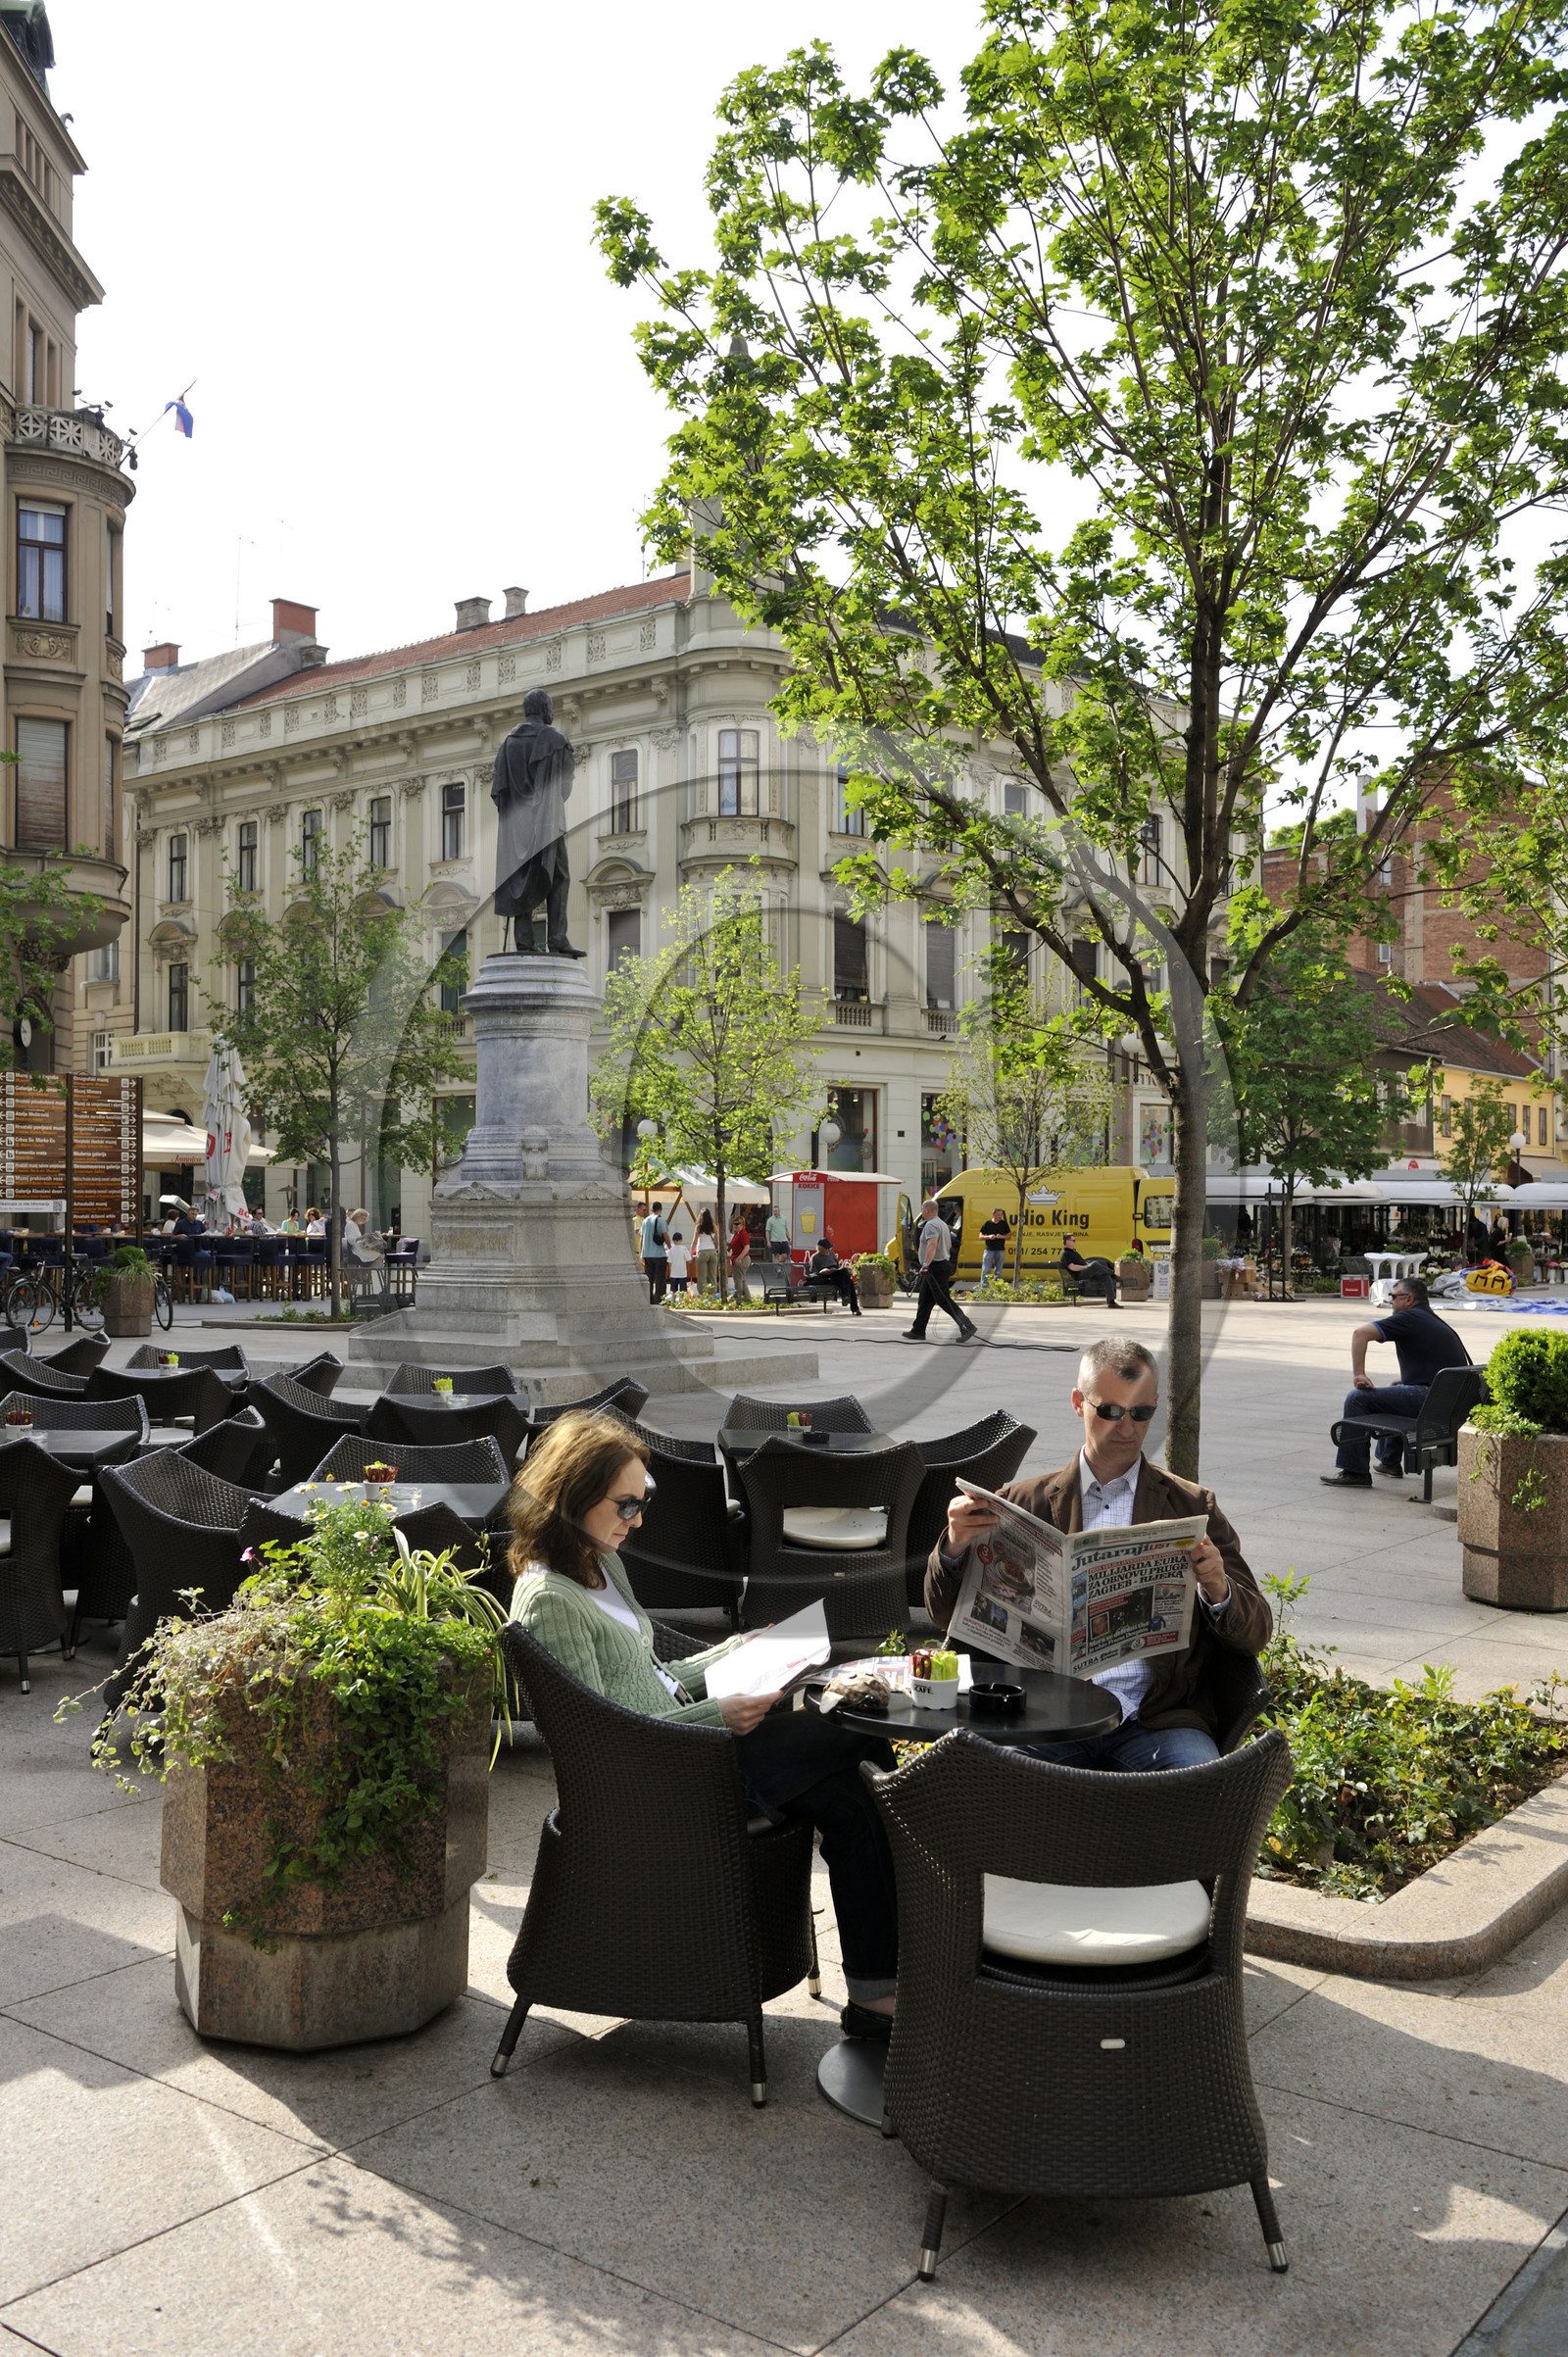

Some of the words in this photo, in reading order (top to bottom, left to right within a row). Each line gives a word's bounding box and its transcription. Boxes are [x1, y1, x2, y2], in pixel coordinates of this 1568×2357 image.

[1052, 1209, 1089, 1229] King
[1072, 1544, 1150, 1572] Jutarnji
[1150, 1543, 1172, 1551] LIST
[1088, 1561, 1152, 1583] MILIJARDA
[1154, 1555, 1188, 1567] EURA
[1088, 1581, 1102, 1592] ZA
[1102, 1570, 1148, 1586] OBNOVU
[1149, 1562, 1188, 1576] PRUGE
[1088, 1579, 1132, 1599] ZAGREB
[1140, 1570, 1184, 1584] RIJEKA
[1073, 1656, 1100, 1672] SUTRA
